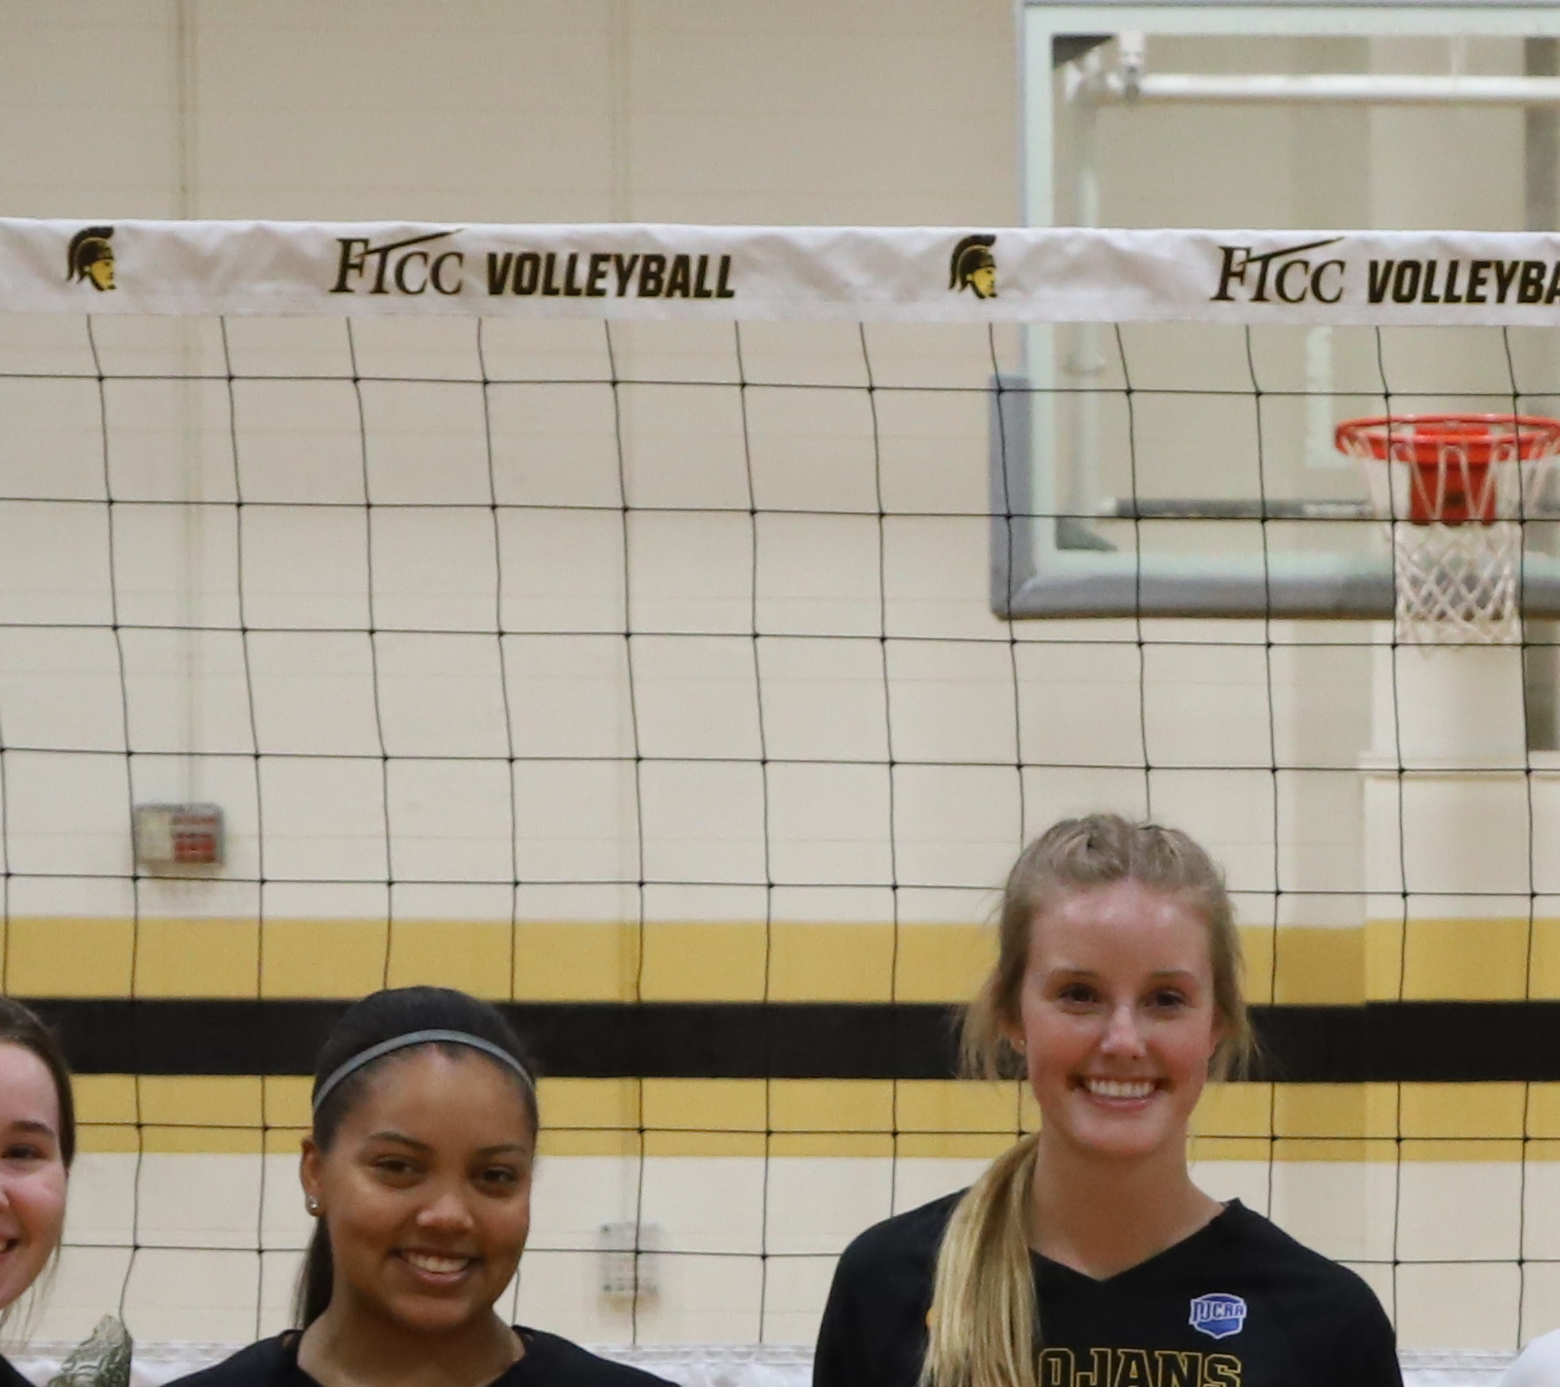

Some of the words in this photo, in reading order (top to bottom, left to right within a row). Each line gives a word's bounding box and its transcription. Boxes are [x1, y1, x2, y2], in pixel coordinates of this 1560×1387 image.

[329, 232, 464, 296] FTCC
[488, 252, 735, 299] VOLLEYBALL
[1210, 240, 1346, 304] FTCC
